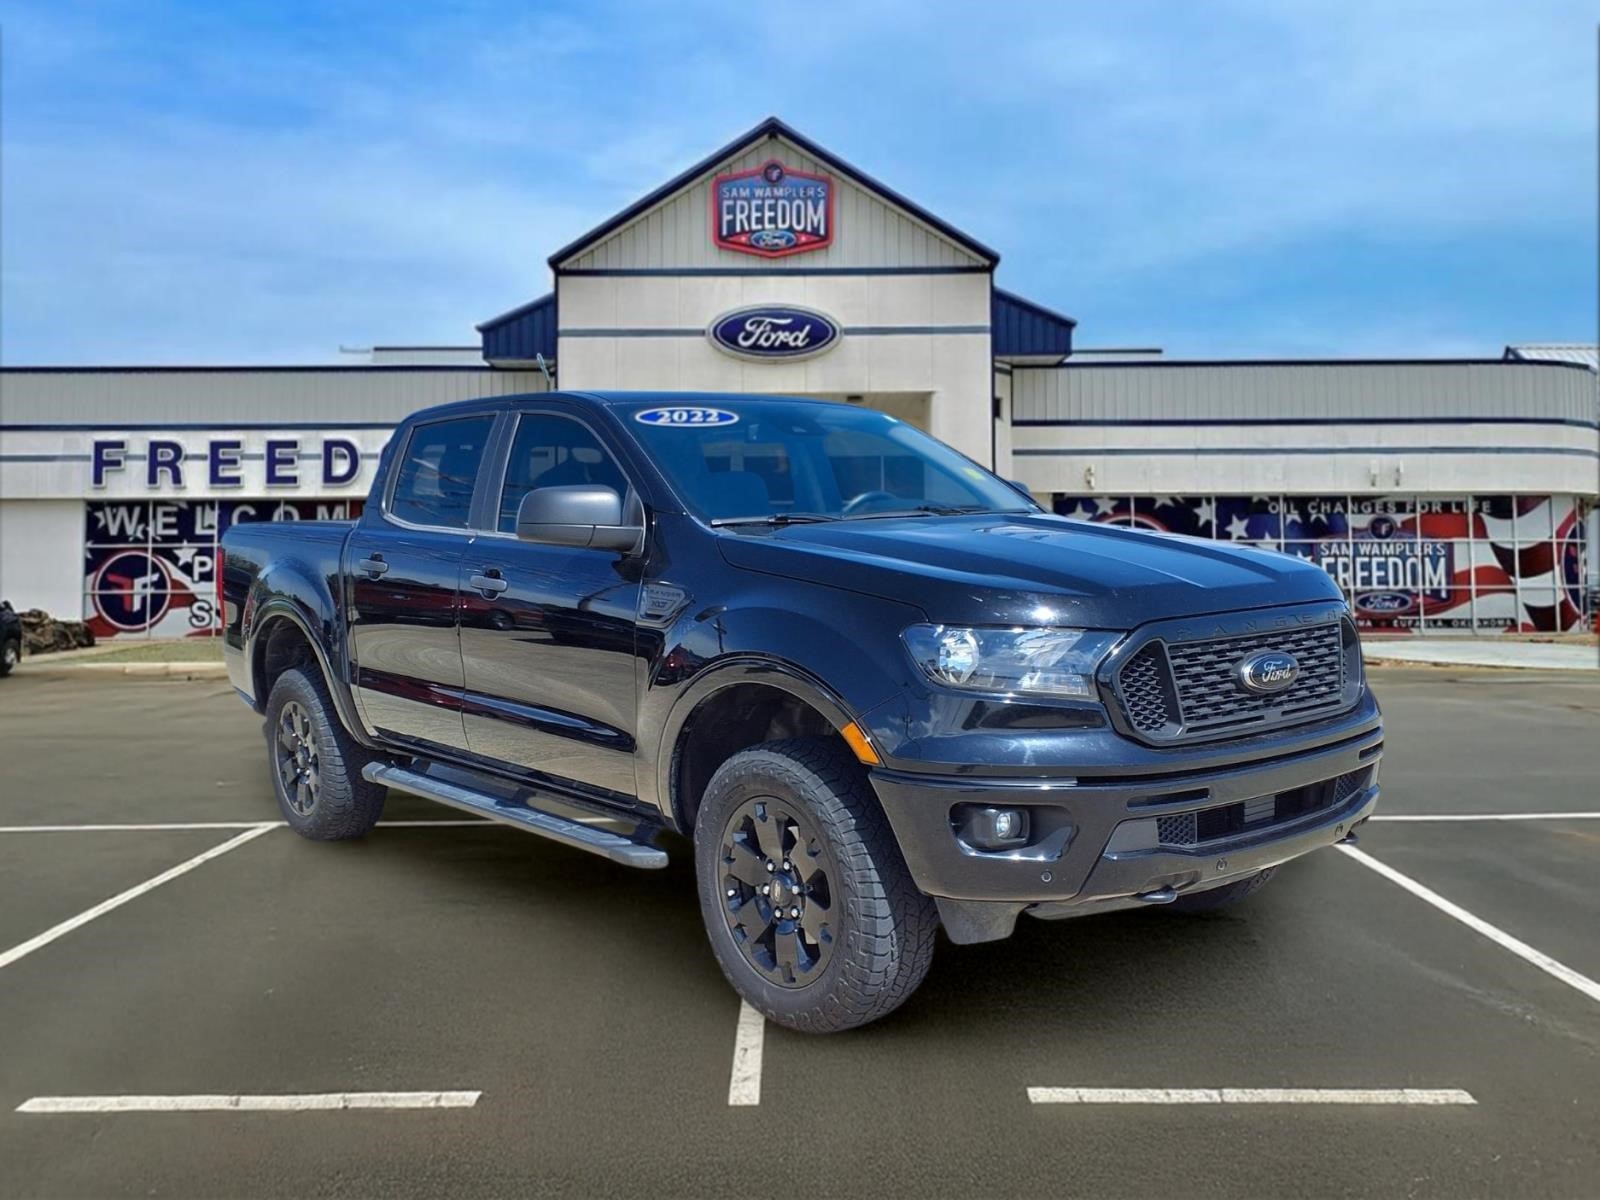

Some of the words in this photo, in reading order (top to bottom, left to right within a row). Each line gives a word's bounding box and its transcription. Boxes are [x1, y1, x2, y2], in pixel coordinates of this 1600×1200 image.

[723, 187, 750, 198] SAM
[722, 199, 825, 236] FREEDOM
[737, 316, 811, 347] Ford
[656, 410, 720, 424] 2022
[1268, 501, 1299, 514] OIL
[1307, 501, 1397, 514] CHANGES
[1406, 501, 1443, 514] FOR
[1451, 500, 1492, 513] LIFE
[1321, 556, 1447, 598] FREEDOM
[1365, 595, 1401, 609] Ford
[1262, 660, 1292, 683] Ford
